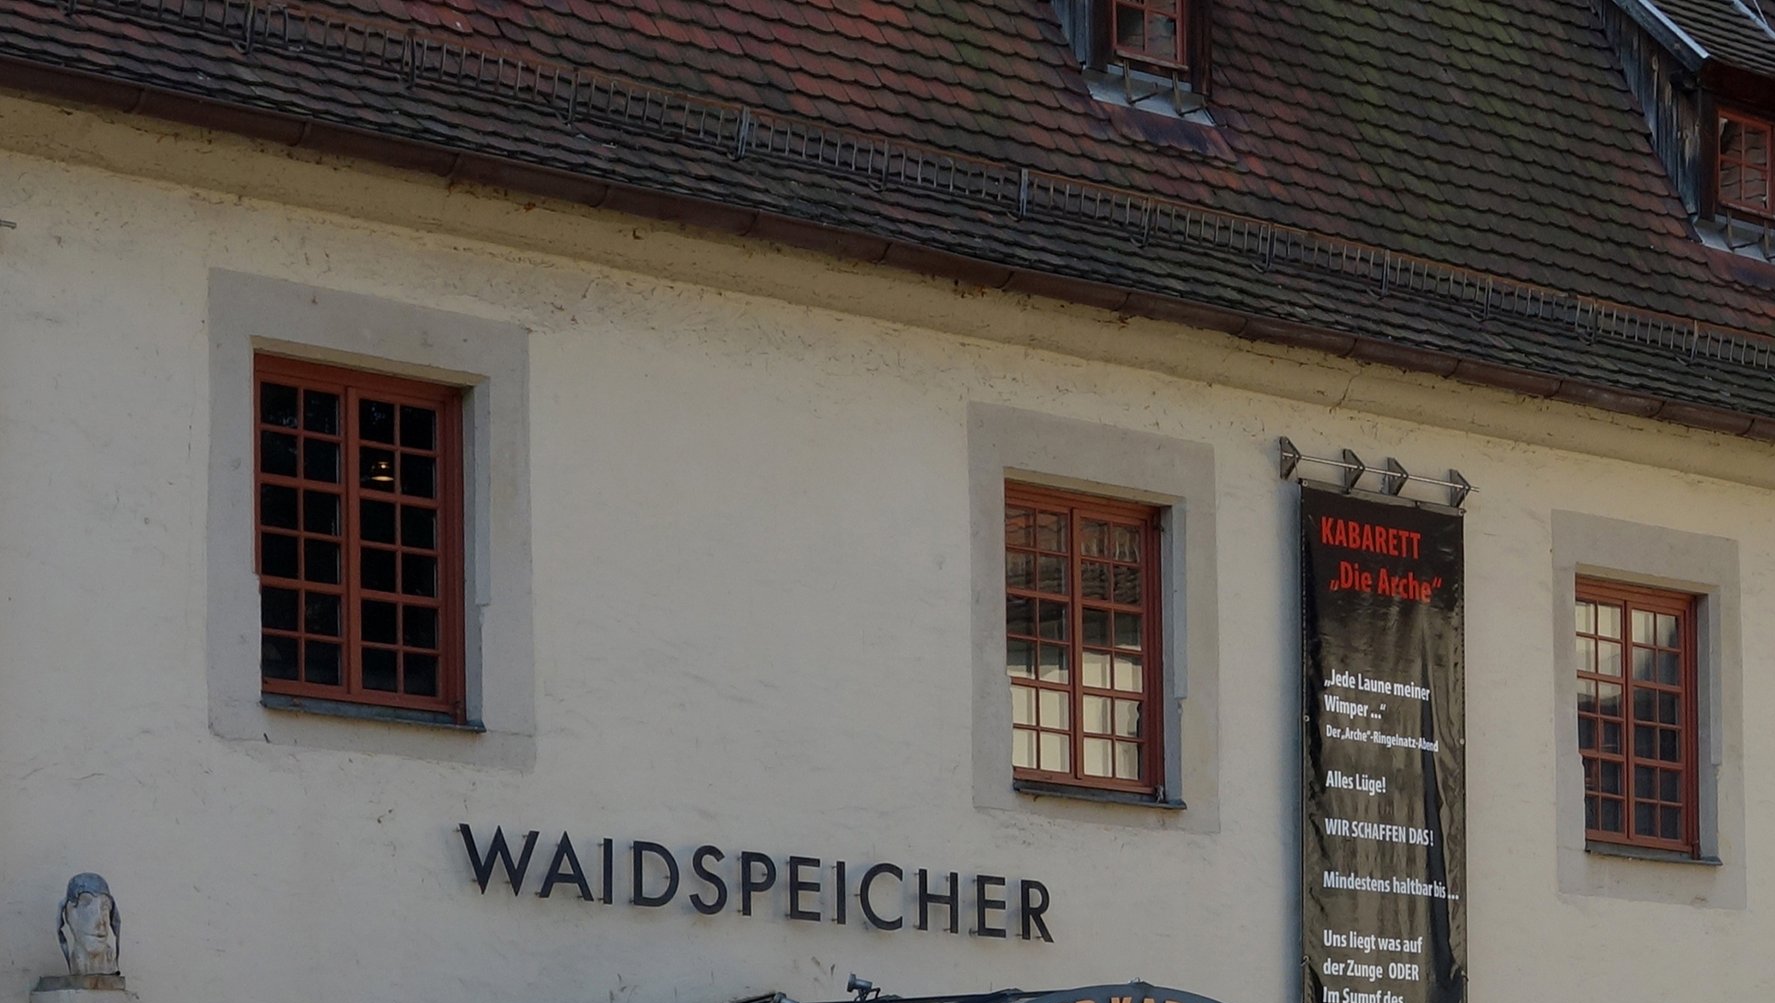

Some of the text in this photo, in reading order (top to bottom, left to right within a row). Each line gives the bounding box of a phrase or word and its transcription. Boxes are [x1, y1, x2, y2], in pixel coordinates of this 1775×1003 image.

[1321, 515, 1421, 560] KABARETT
[1358, 673, 1392, 695] Laune
[1393, 682, 1431, 701] meiner
[1324, 695, 1369, 719] Wimper
[1325, 770, 1386, 796] Alles Lüge!
[1325, 818, 1350, 837] WIR
[1351, 821, 1406, 843] SCHAFFEN
[458, 822, 1054, 943] WAIDSPEICHER
[1323, 870, 1390, 893] Mindestens
[1392, 876, 1433, 898] haltbar
[1433, 880, 1446, 899] bis
[1323, 929, 1423, 954] Uns liegt was auf
[1323, 957, 1420, 982] der Zunge ODER
[1322, 986, 1340, 1003] Im
